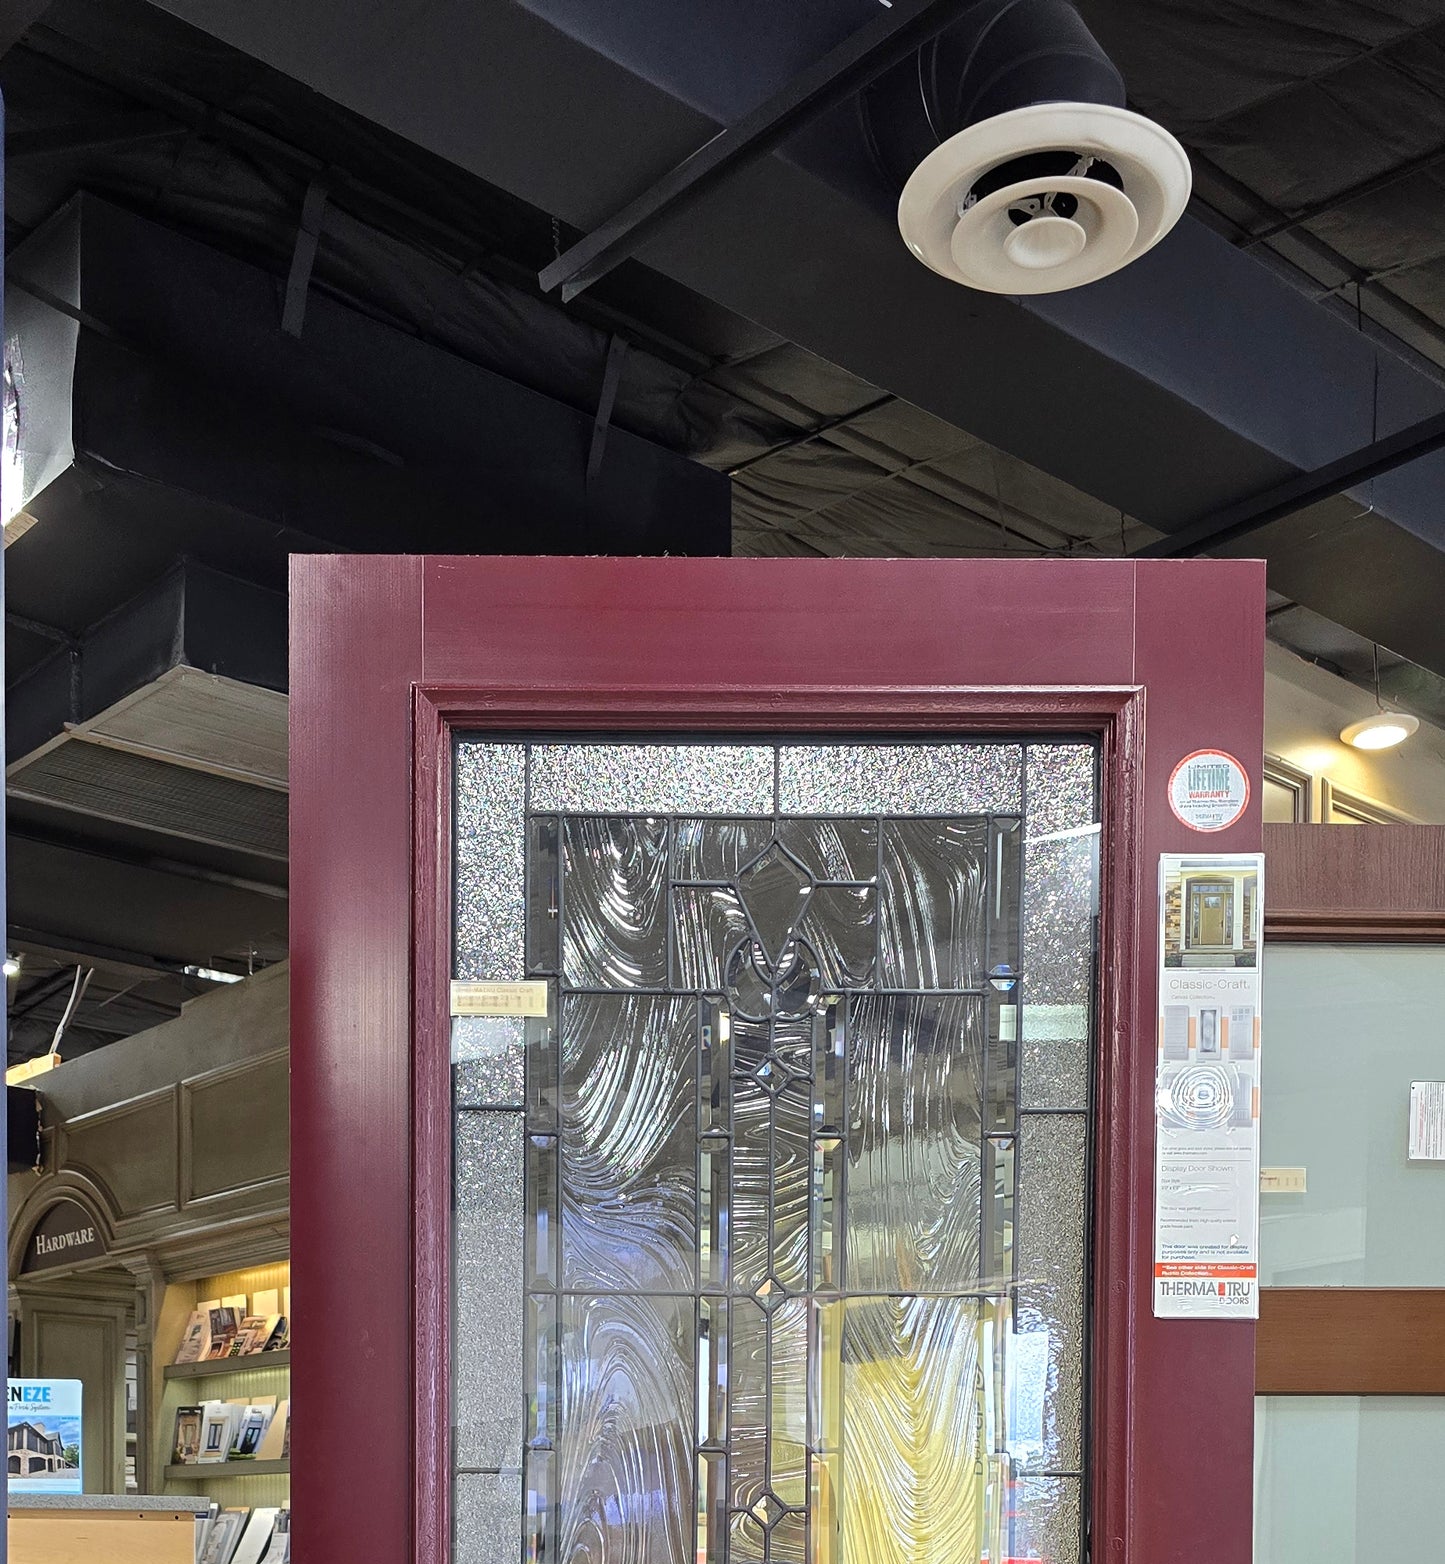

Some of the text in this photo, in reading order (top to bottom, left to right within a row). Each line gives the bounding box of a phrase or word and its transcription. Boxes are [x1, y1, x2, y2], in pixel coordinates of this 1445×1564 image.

[1188, 769, 1230, 790] LIFETIME
[1188, 790, 1230, 799] WARRANTY
[1161, 1165, 1187, 1173] Display
[36, 1227, 95, 1255] HARDWARE
[1159, 1281, 1250, 1297] THERMA TRU
[1219, 1297, 1250, 1305] DOORS
[7, 1386, 51, 1402] NEZE
